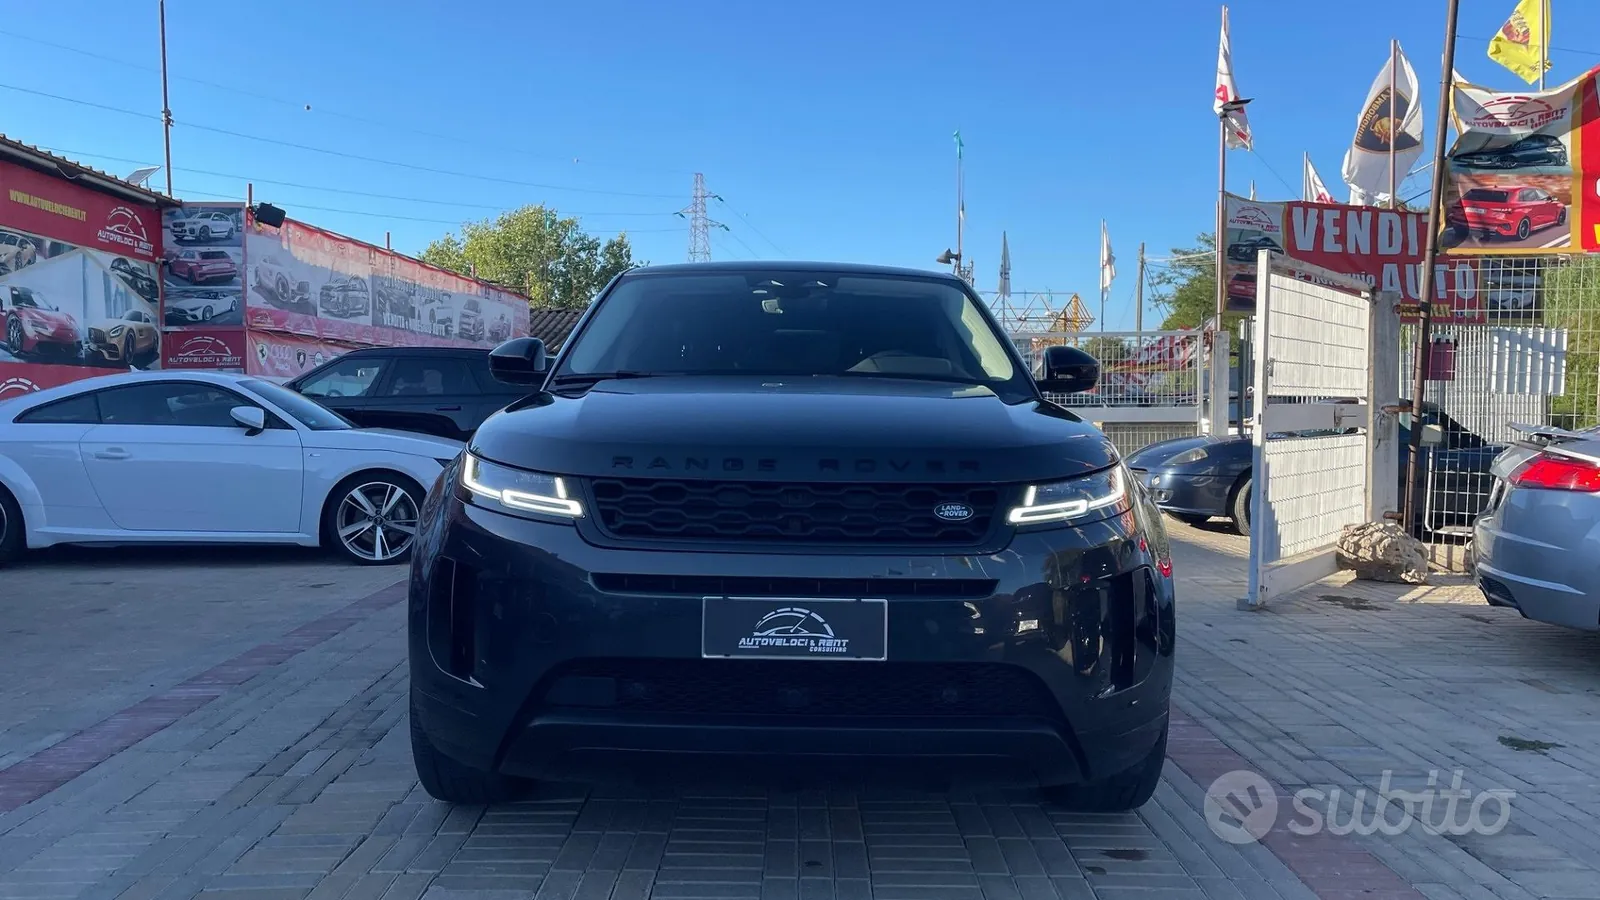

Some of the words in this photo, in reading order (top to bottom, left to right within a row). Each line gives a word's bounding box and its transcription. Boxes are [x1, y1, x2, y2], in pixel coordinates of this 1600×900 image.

[1382, 262, 1477, 300] AUTO
[611, 455, 778, 472] RANGE
[818, 458, 982, 475] ROVER
[738, 637, 809, 647] AUTOVELOCI
[810, 639, 816, 647] &
[818, 639, 849, 647] RENT
